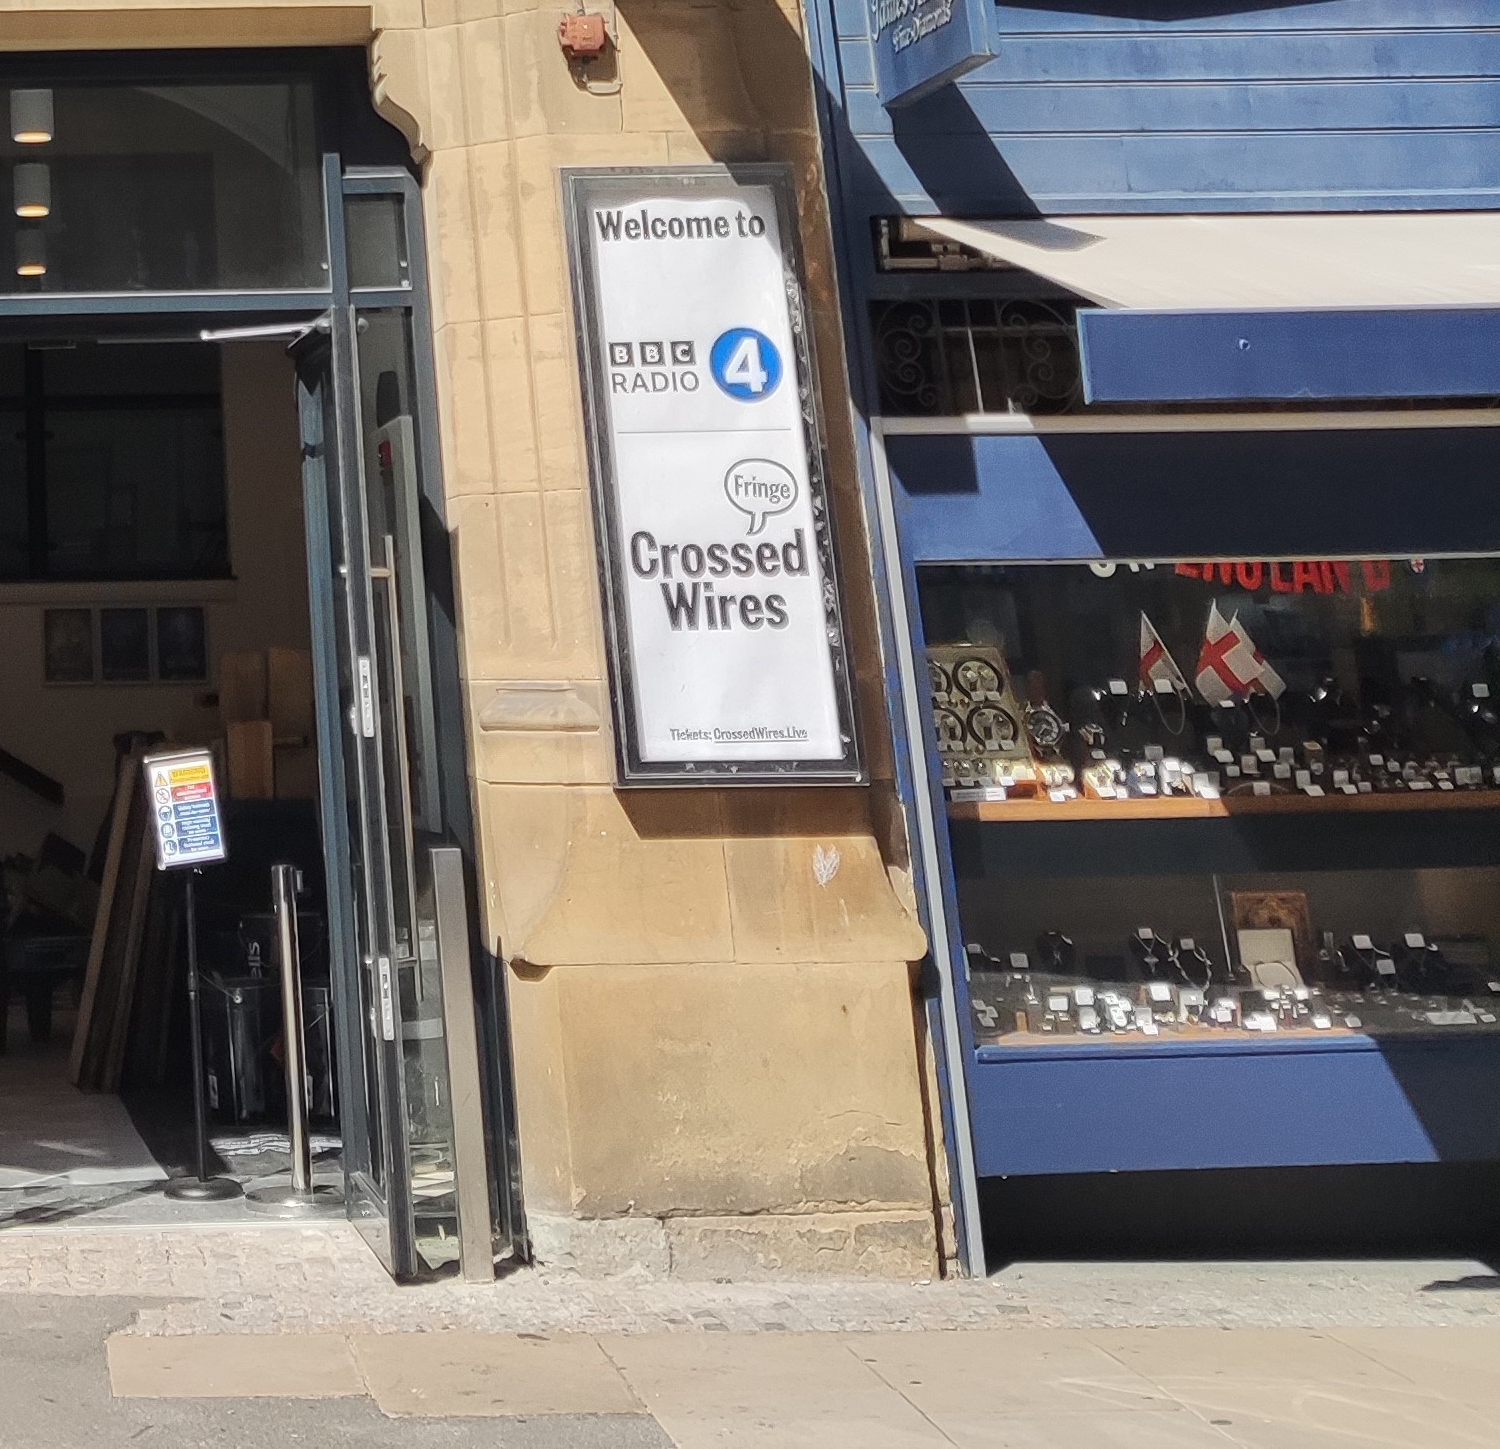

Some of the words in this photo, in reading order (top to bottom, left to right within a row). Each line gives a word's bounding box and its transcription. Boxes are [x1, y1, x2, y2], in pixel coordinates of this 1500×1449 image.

[595, 209, 730, 242] Welcome
[735, 211, 766, 238] to
[609, 342, 698, 368] BBC
[612, 371, 700, 394] RADIO
[725, 337, 768, 393] 4
[734, 474, 791, 504] Fringe
[630, 528, 810, 580] Crossed
[660, 581, 790, 631] Wires
[670, 727, 712, 741] Tickets:
[714, 725, 809, 741] CrossedWires.Live
